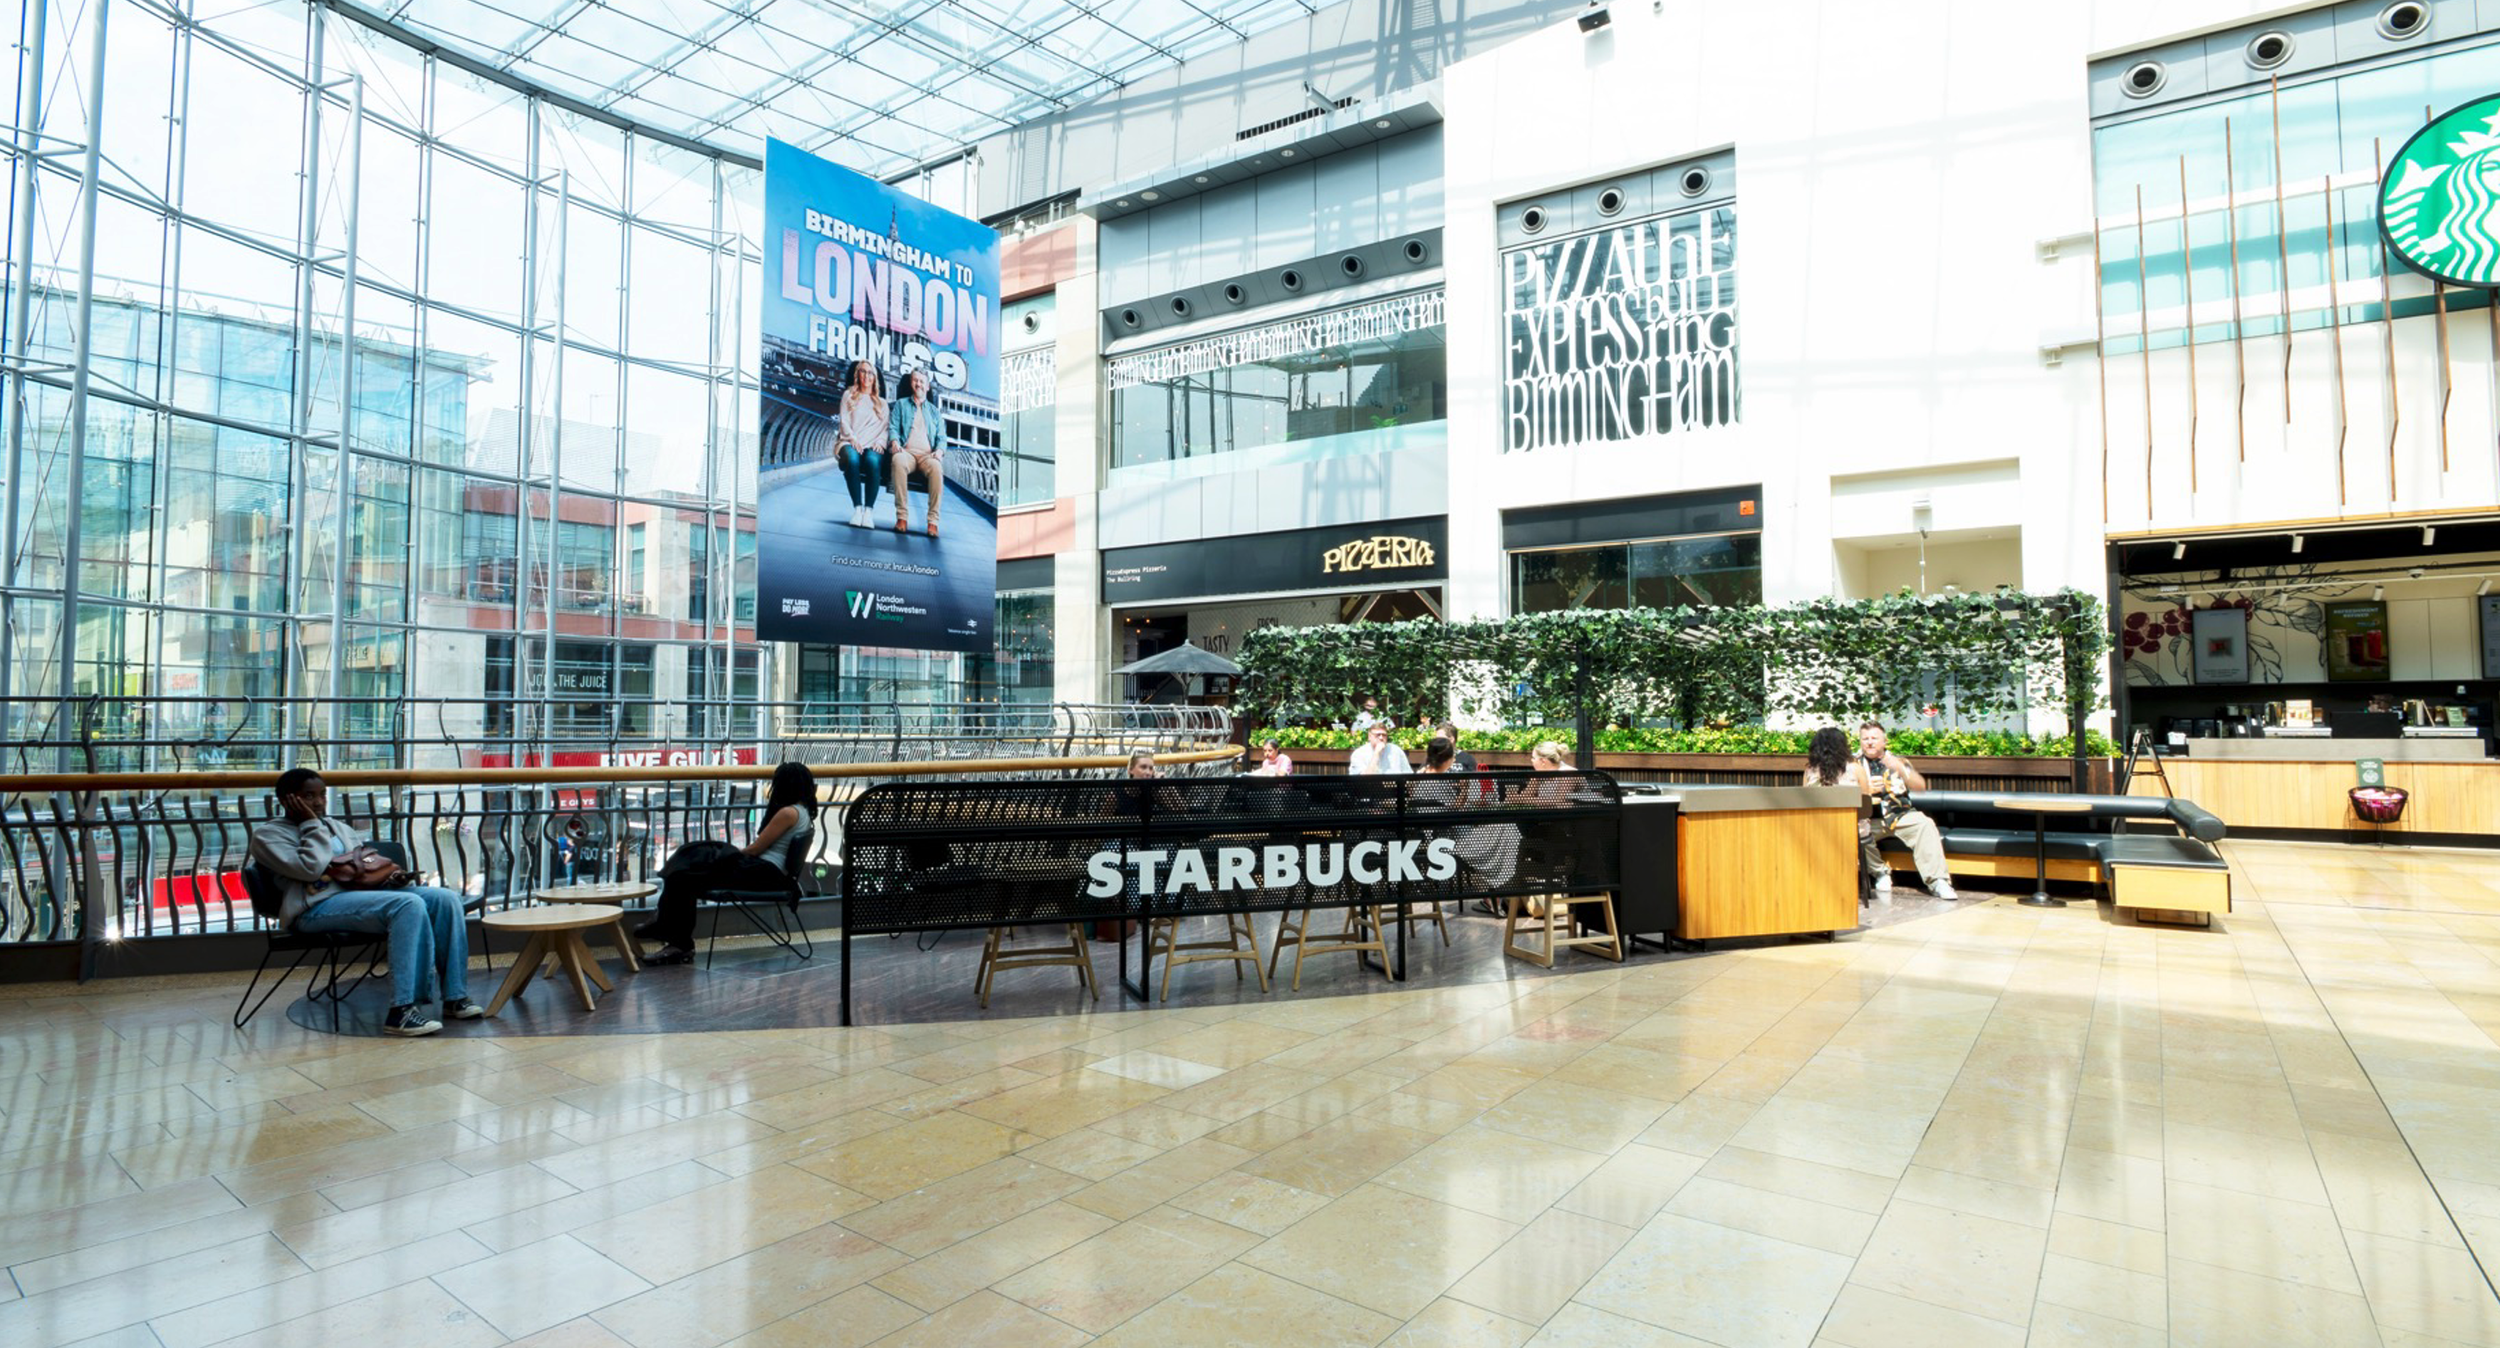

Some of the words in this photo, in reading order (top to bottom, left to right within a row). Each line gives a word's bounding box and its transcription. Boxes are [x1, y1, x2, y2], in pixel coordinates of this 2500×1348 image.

[804, 208, 950, 280] BIRMINGHAM
[955, 263, 973, 287] TO
[782, 226, 988, 357] LONDON
[809, 313, 891, 372] FROM
[900, 341, 967, 391] £9
[831, 555, 848, 565] Find
[849, 558, 862, 567] out
[864, 560, 882, 569] more
[883, 562, 892, 570] at
[1322, 536, 1435, 573] PIZZERIA
[876, 593, 905, 605] London
[875, 611, 904, 623] Railway
[876, 602, 927, 615] Northwestern
[1202, 634, 1230, 654] TASTY
[558, 674, 577, 688] THE
[580, 675, 607, 689] JUICE
[600, 751, 661, 767] FIVE
[1086, 838, 1457, 899] STARBUCKS
